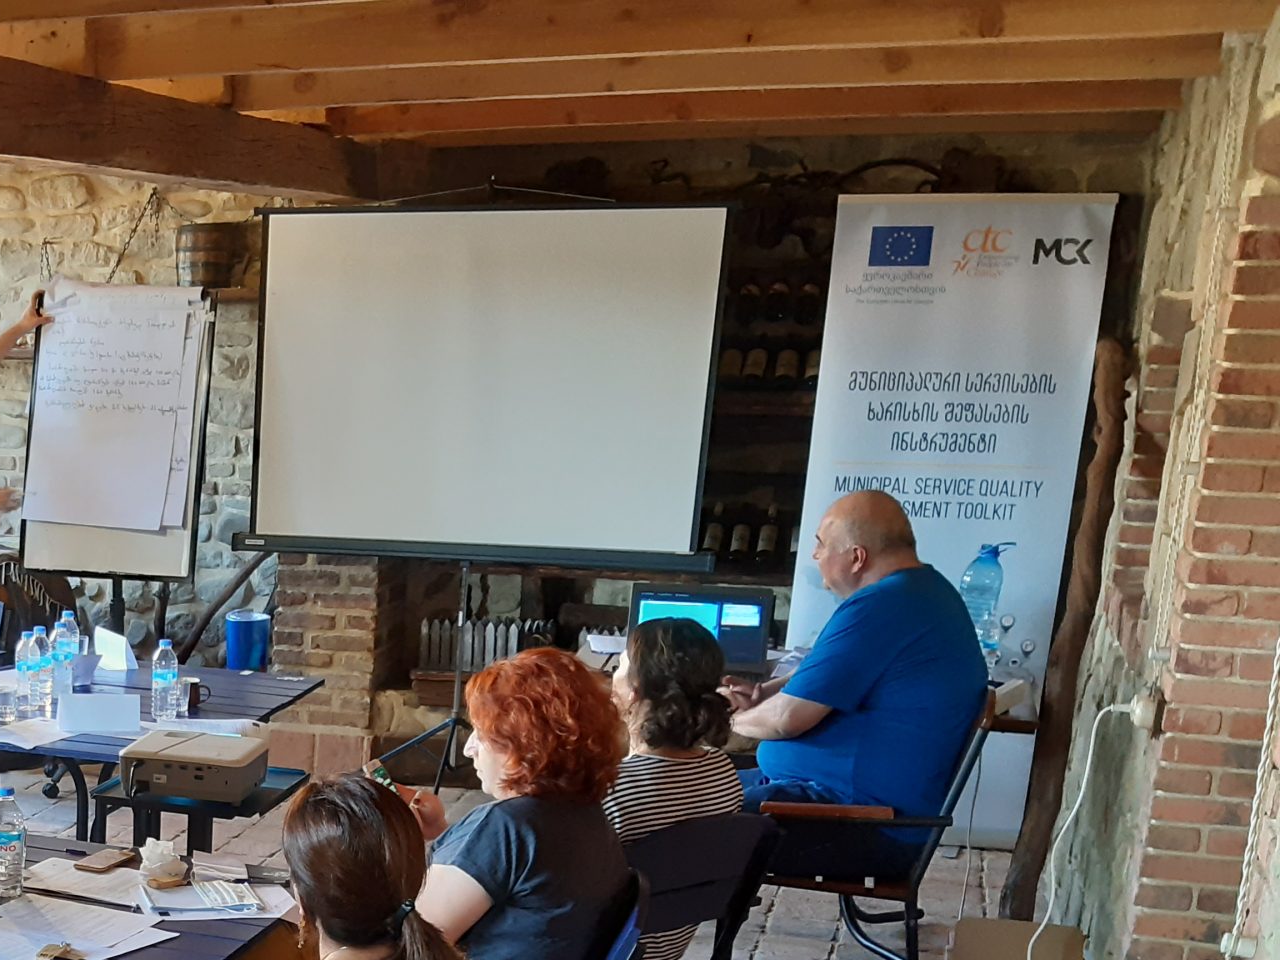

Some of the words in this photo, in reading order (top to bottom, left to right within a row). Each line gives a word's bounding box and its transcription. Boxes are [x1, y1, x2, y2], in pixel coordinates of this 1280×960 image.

[834, 476, 909, 494] MUNICIPAL
[913, 477, 976, 496] SERVICE
[978, 479, 1044, 498] QUALITY
[955, 502, 1017, 520] TOOLKIT
